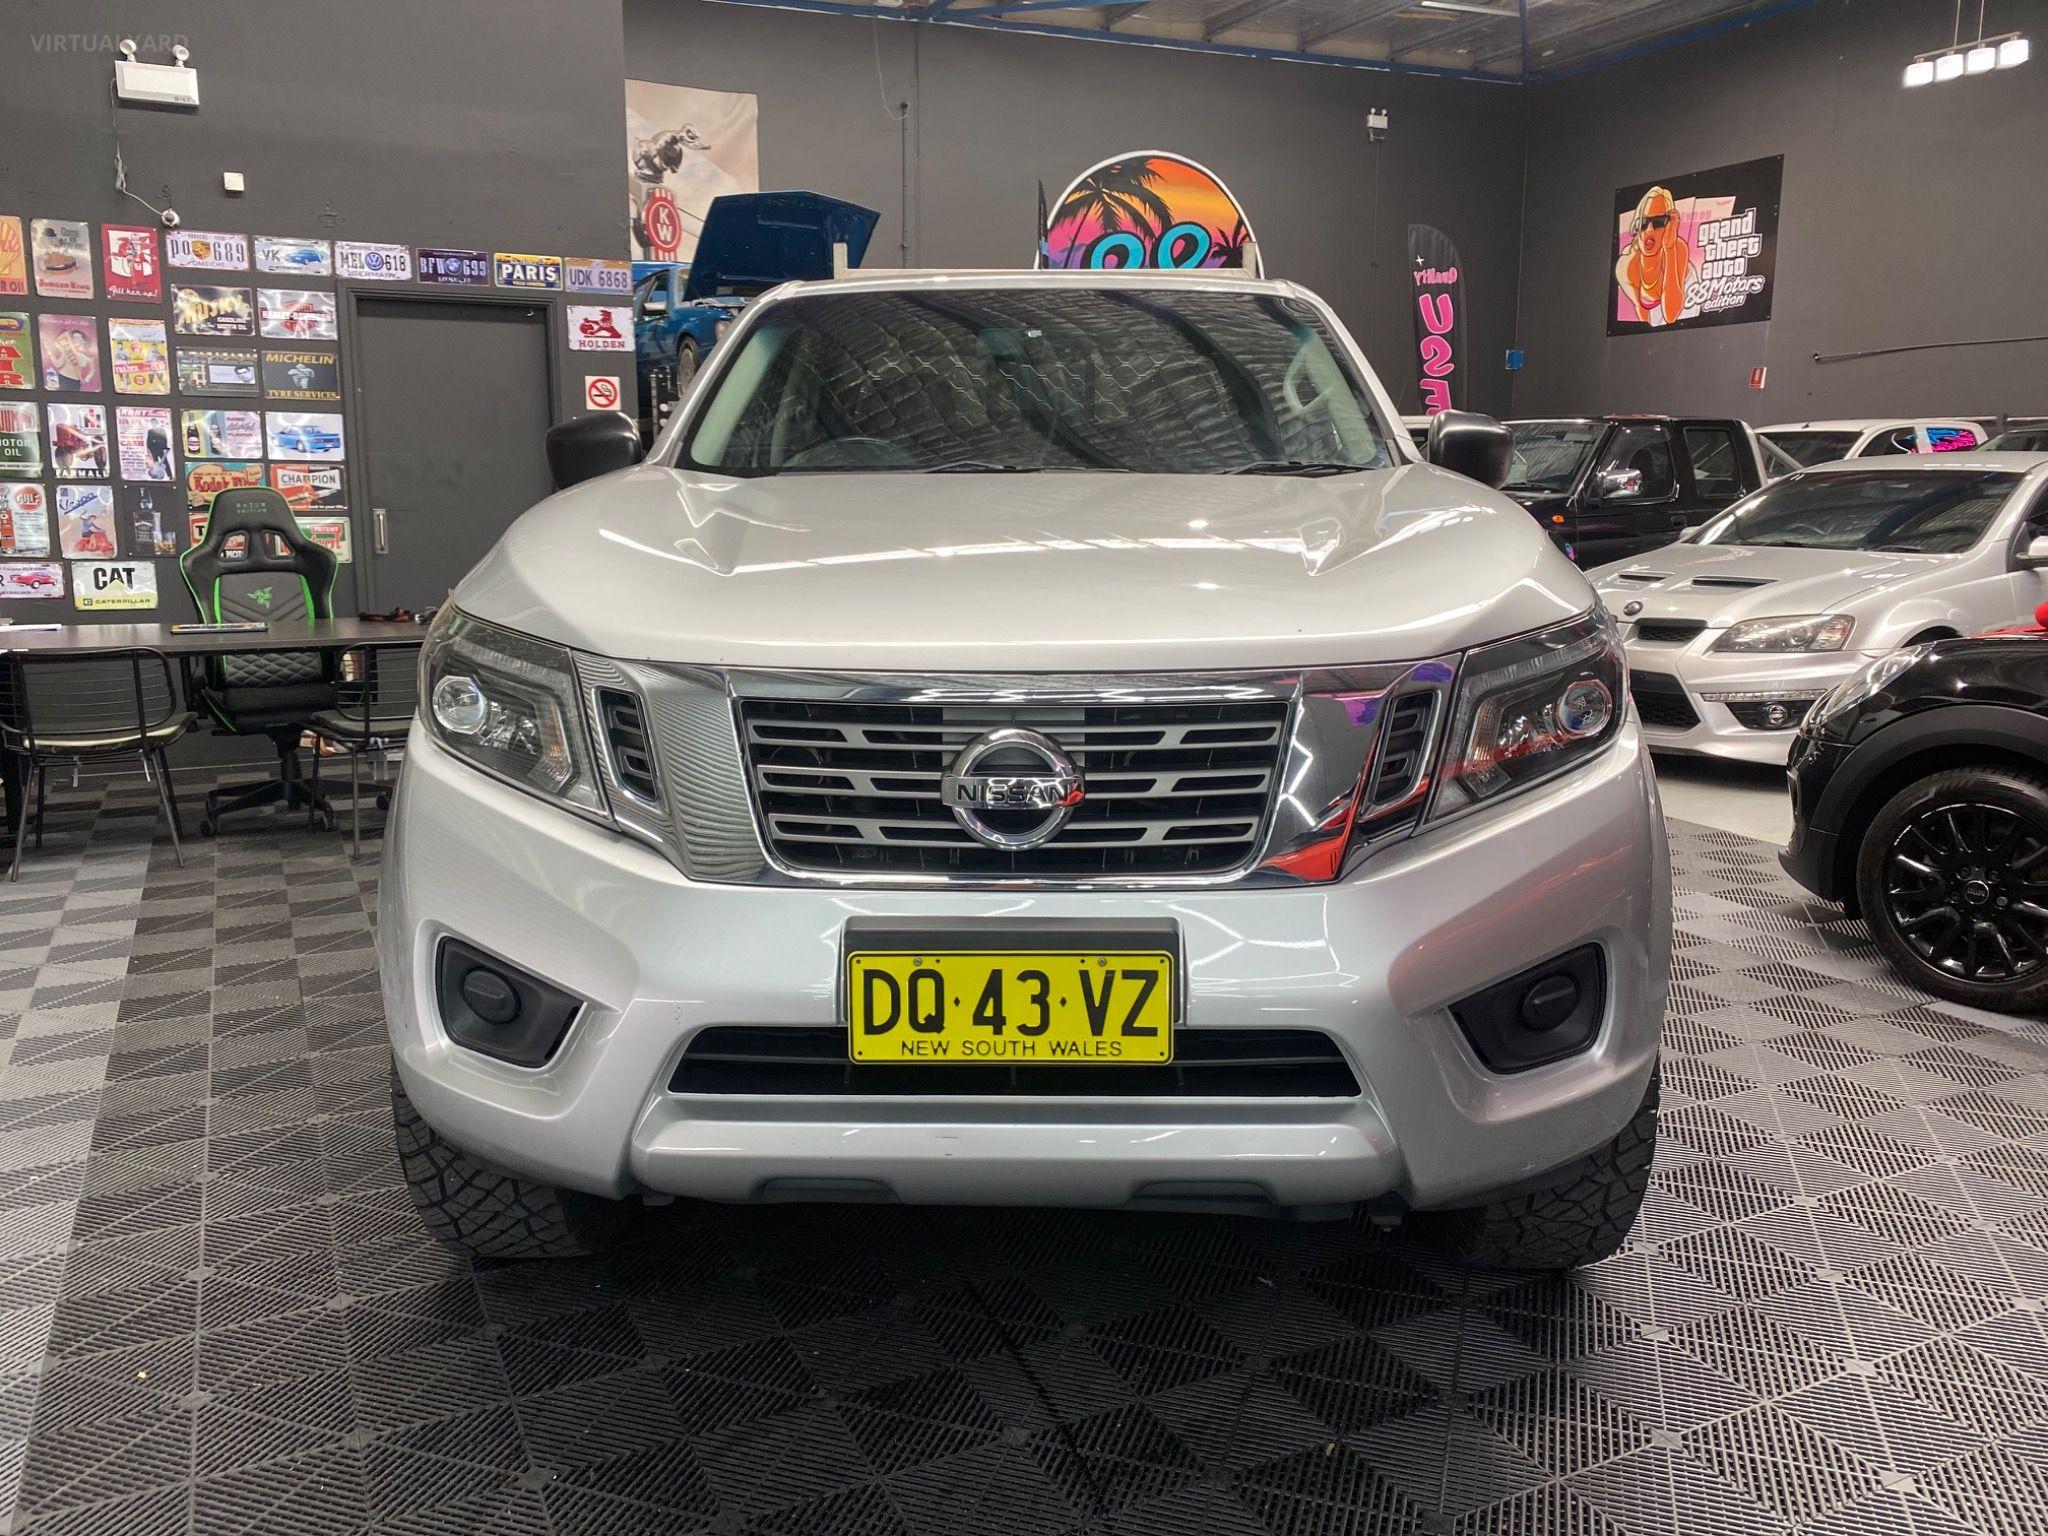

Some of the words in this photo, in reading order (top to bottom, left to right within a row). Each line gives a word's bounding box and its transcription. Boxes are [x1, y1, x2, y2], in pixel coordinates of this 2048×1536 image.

[1698, 209, 1755, 247] grand
[213, 242, 245, 262] 689
[262, 249, 280, 262] VK
[1704, 235, 1761, 262] theft
[385, 254, 406, 272] 618
[463, 259, 487, 276] 699
[1702, 257, 1746, 280] auto
[501, 264, 557, 281] PARIS
[569, 268, 593, 286] UDK
[598, 270, 628, 288] 6868
[1703, 293, 1745, 311] edition
[579, 340, 625, 348] HOLDEN
[266, 354, 334, 364] MICHELIN
[268, 389, 293, 399] TYRE
[293, 390, 337, 399] SERVICES
[4, 448, 22, 456] OIL
[281, 474, 336, 484] CHAMPION
[16, 493, 40, 505] GULF
[93, 567, 135, 591] CAT
[957, 784, 1069, 804] NISSAN
[901, 1040, 950, 1056] NEW
[962, 1040, 1035, 1057] SOUTH
[1049, 1040, 1123, 1057] WALES
